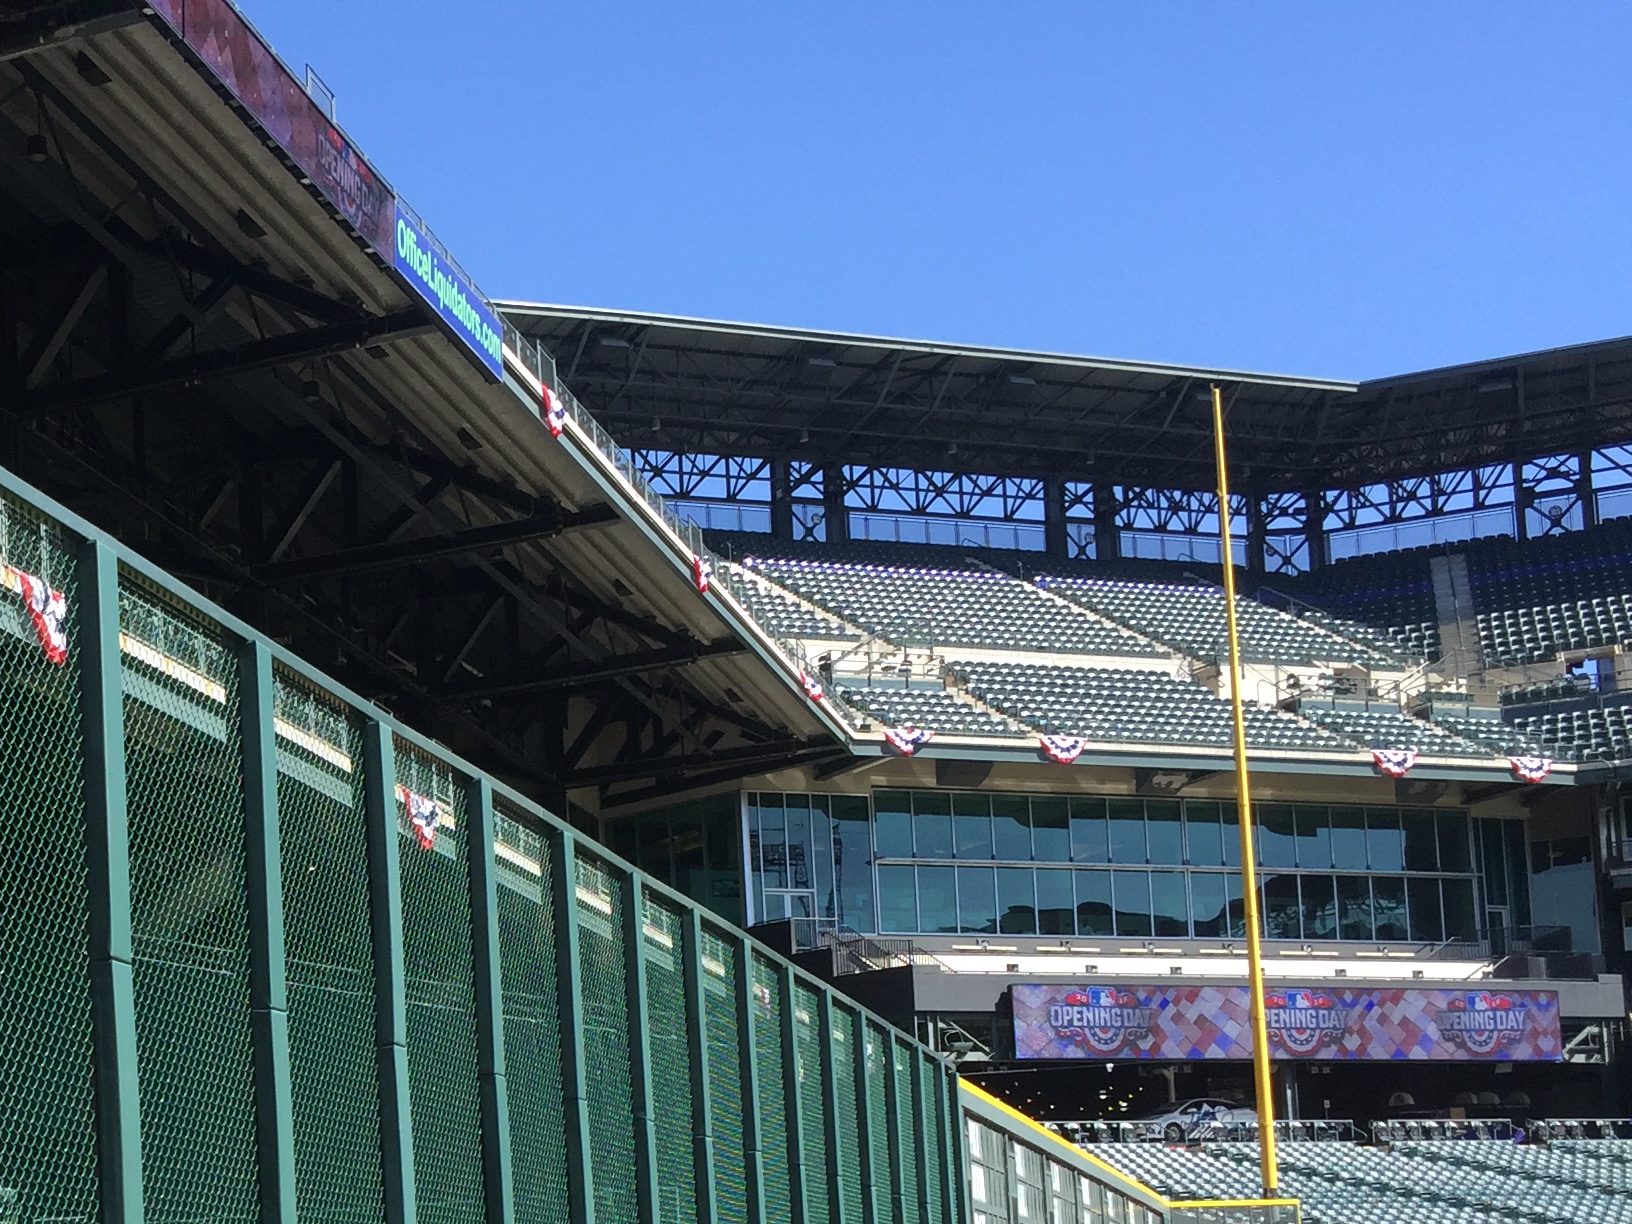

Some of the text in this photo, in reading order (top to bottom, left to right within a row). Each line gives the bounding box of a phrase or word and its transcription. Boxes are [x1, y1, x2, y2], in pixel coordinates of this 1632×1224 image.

[397, 219, 502, 364] OfficeLiquidators.com
[1050, 1006, 1153, 1027] OPENING DAY
[1318, 1009, 1348, 1028] DAY
[1496, 1011, 1525, 1031] DAY
